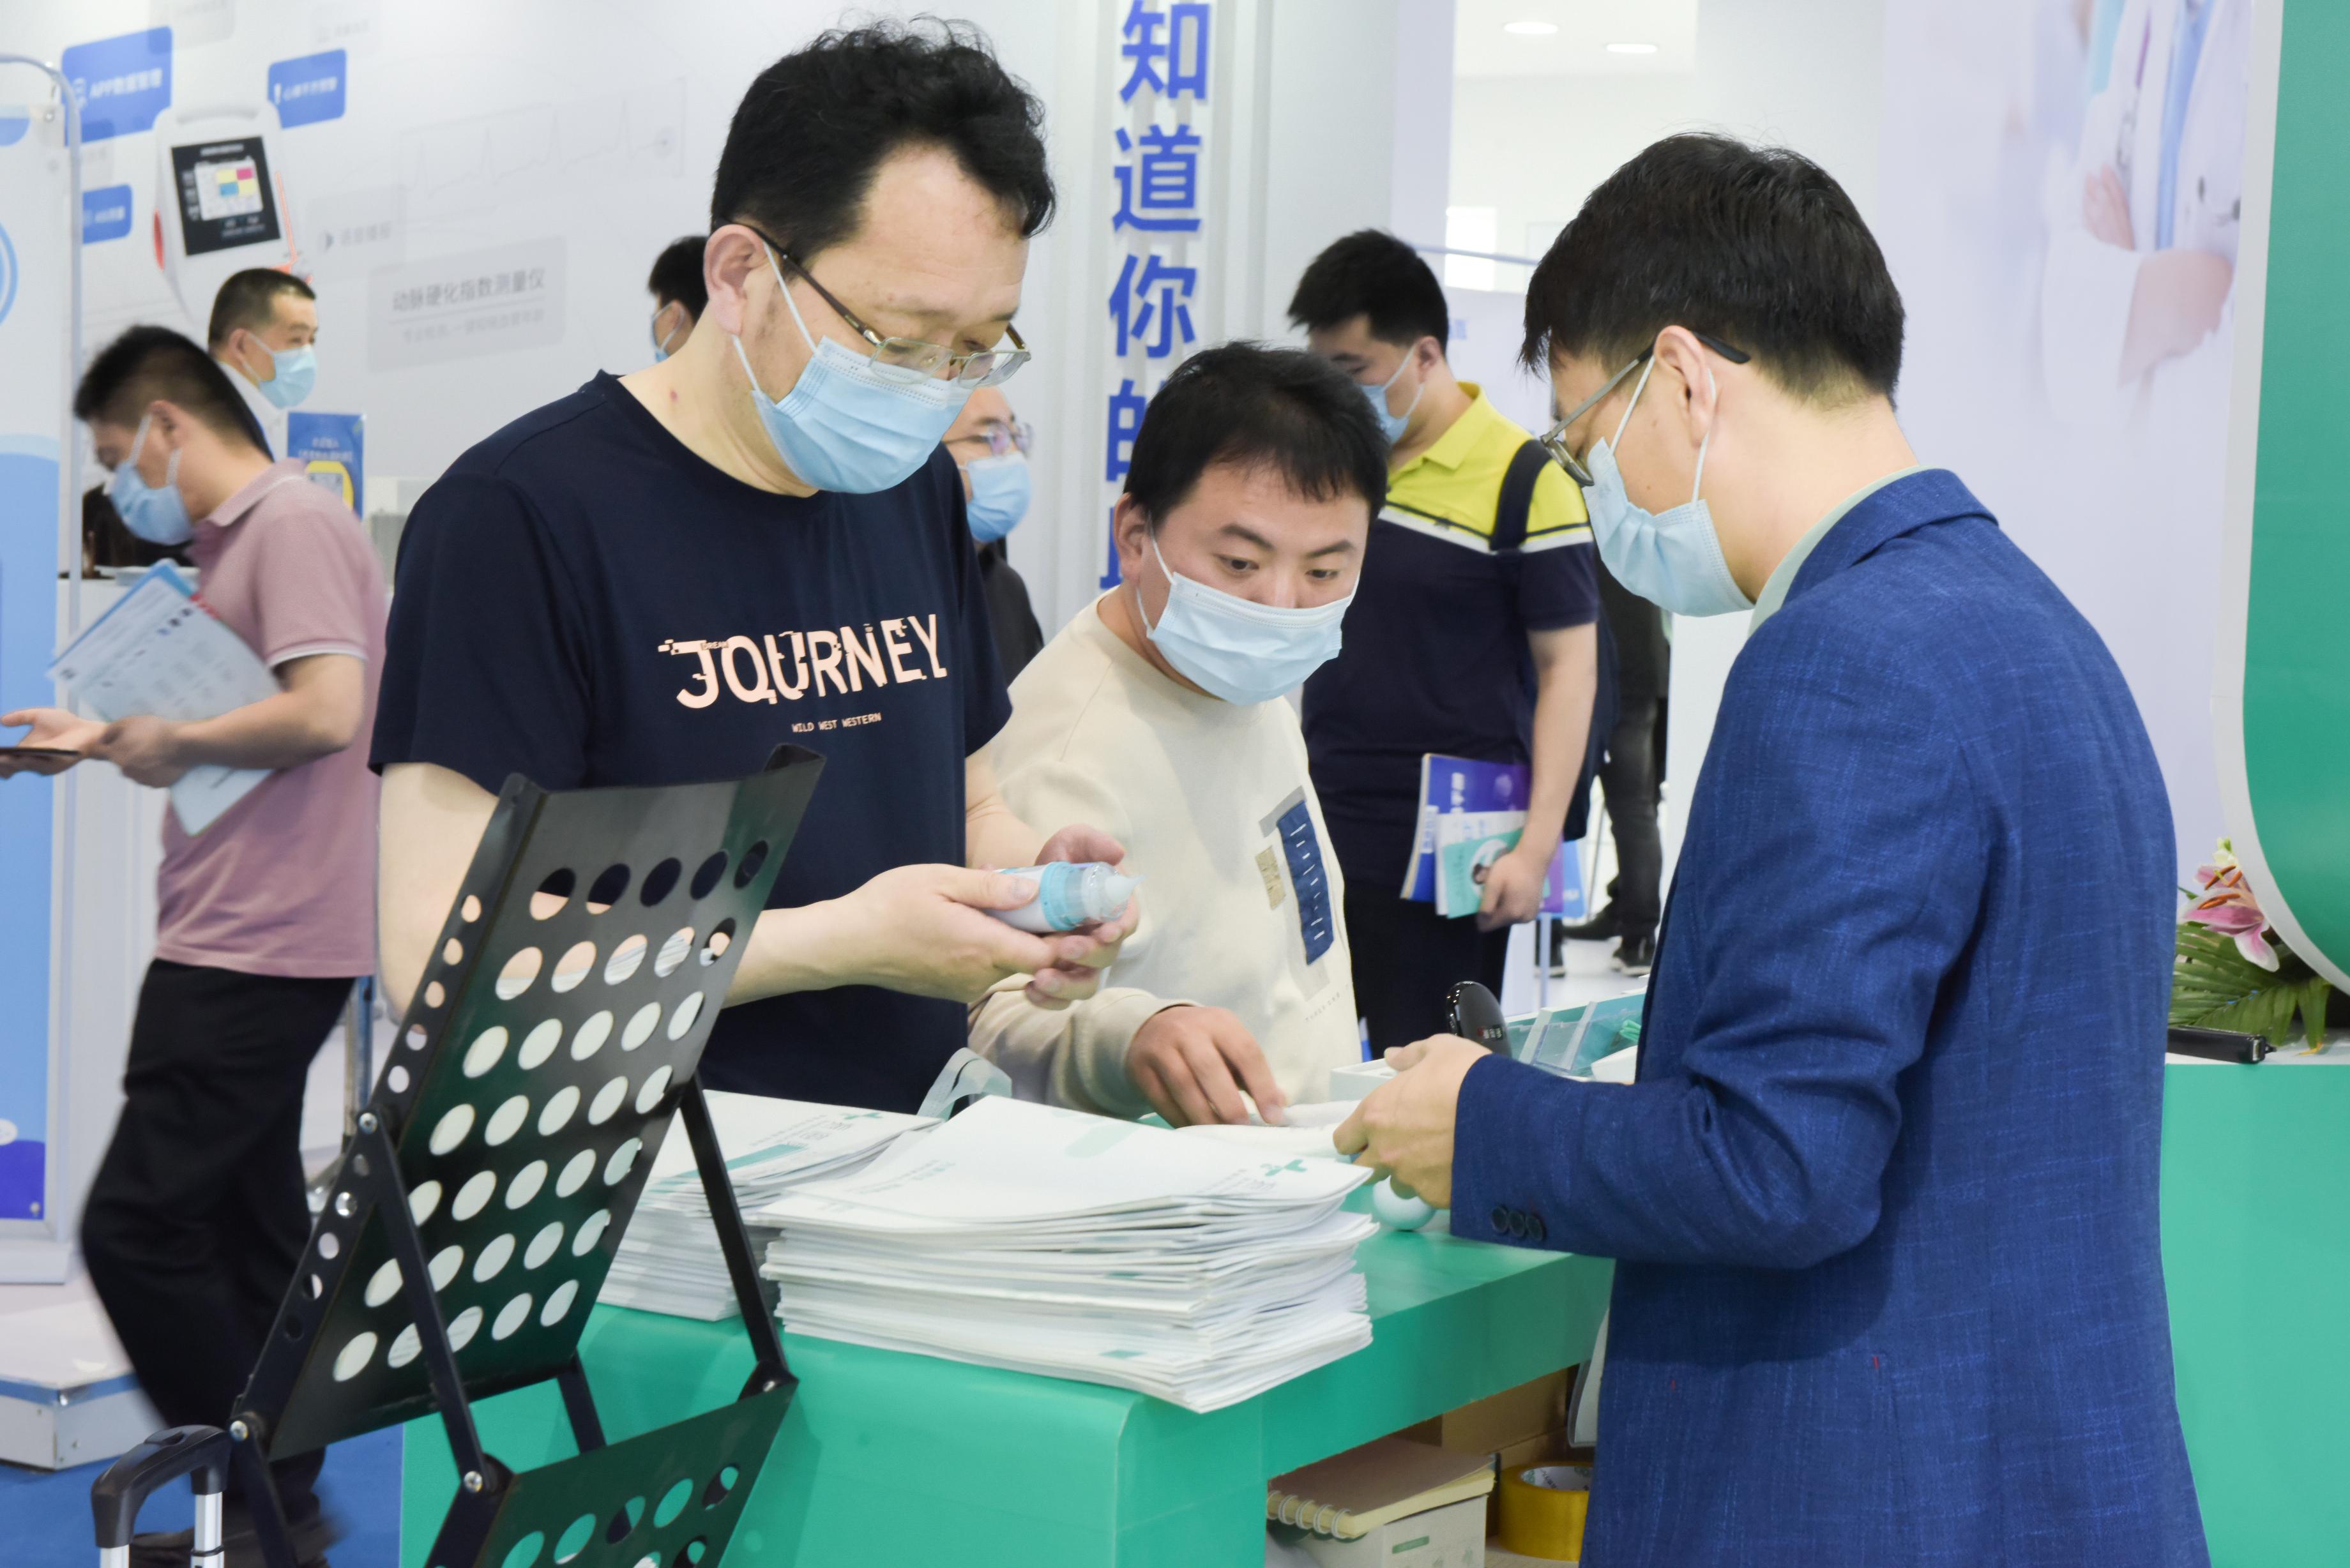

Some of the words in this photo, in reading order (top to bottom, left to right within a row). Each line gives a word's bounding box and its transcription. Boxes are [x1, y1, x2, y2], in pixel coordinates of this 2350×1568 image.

[392, 267, 546, 311] 动脉硬化指数测量仪
[658, 614, 948, 709] JOURNEY
[791, 721, 815, 733] WILD
[818, 720, 838, 730] WEST
[841, 712, 883, 728] WESTERN
